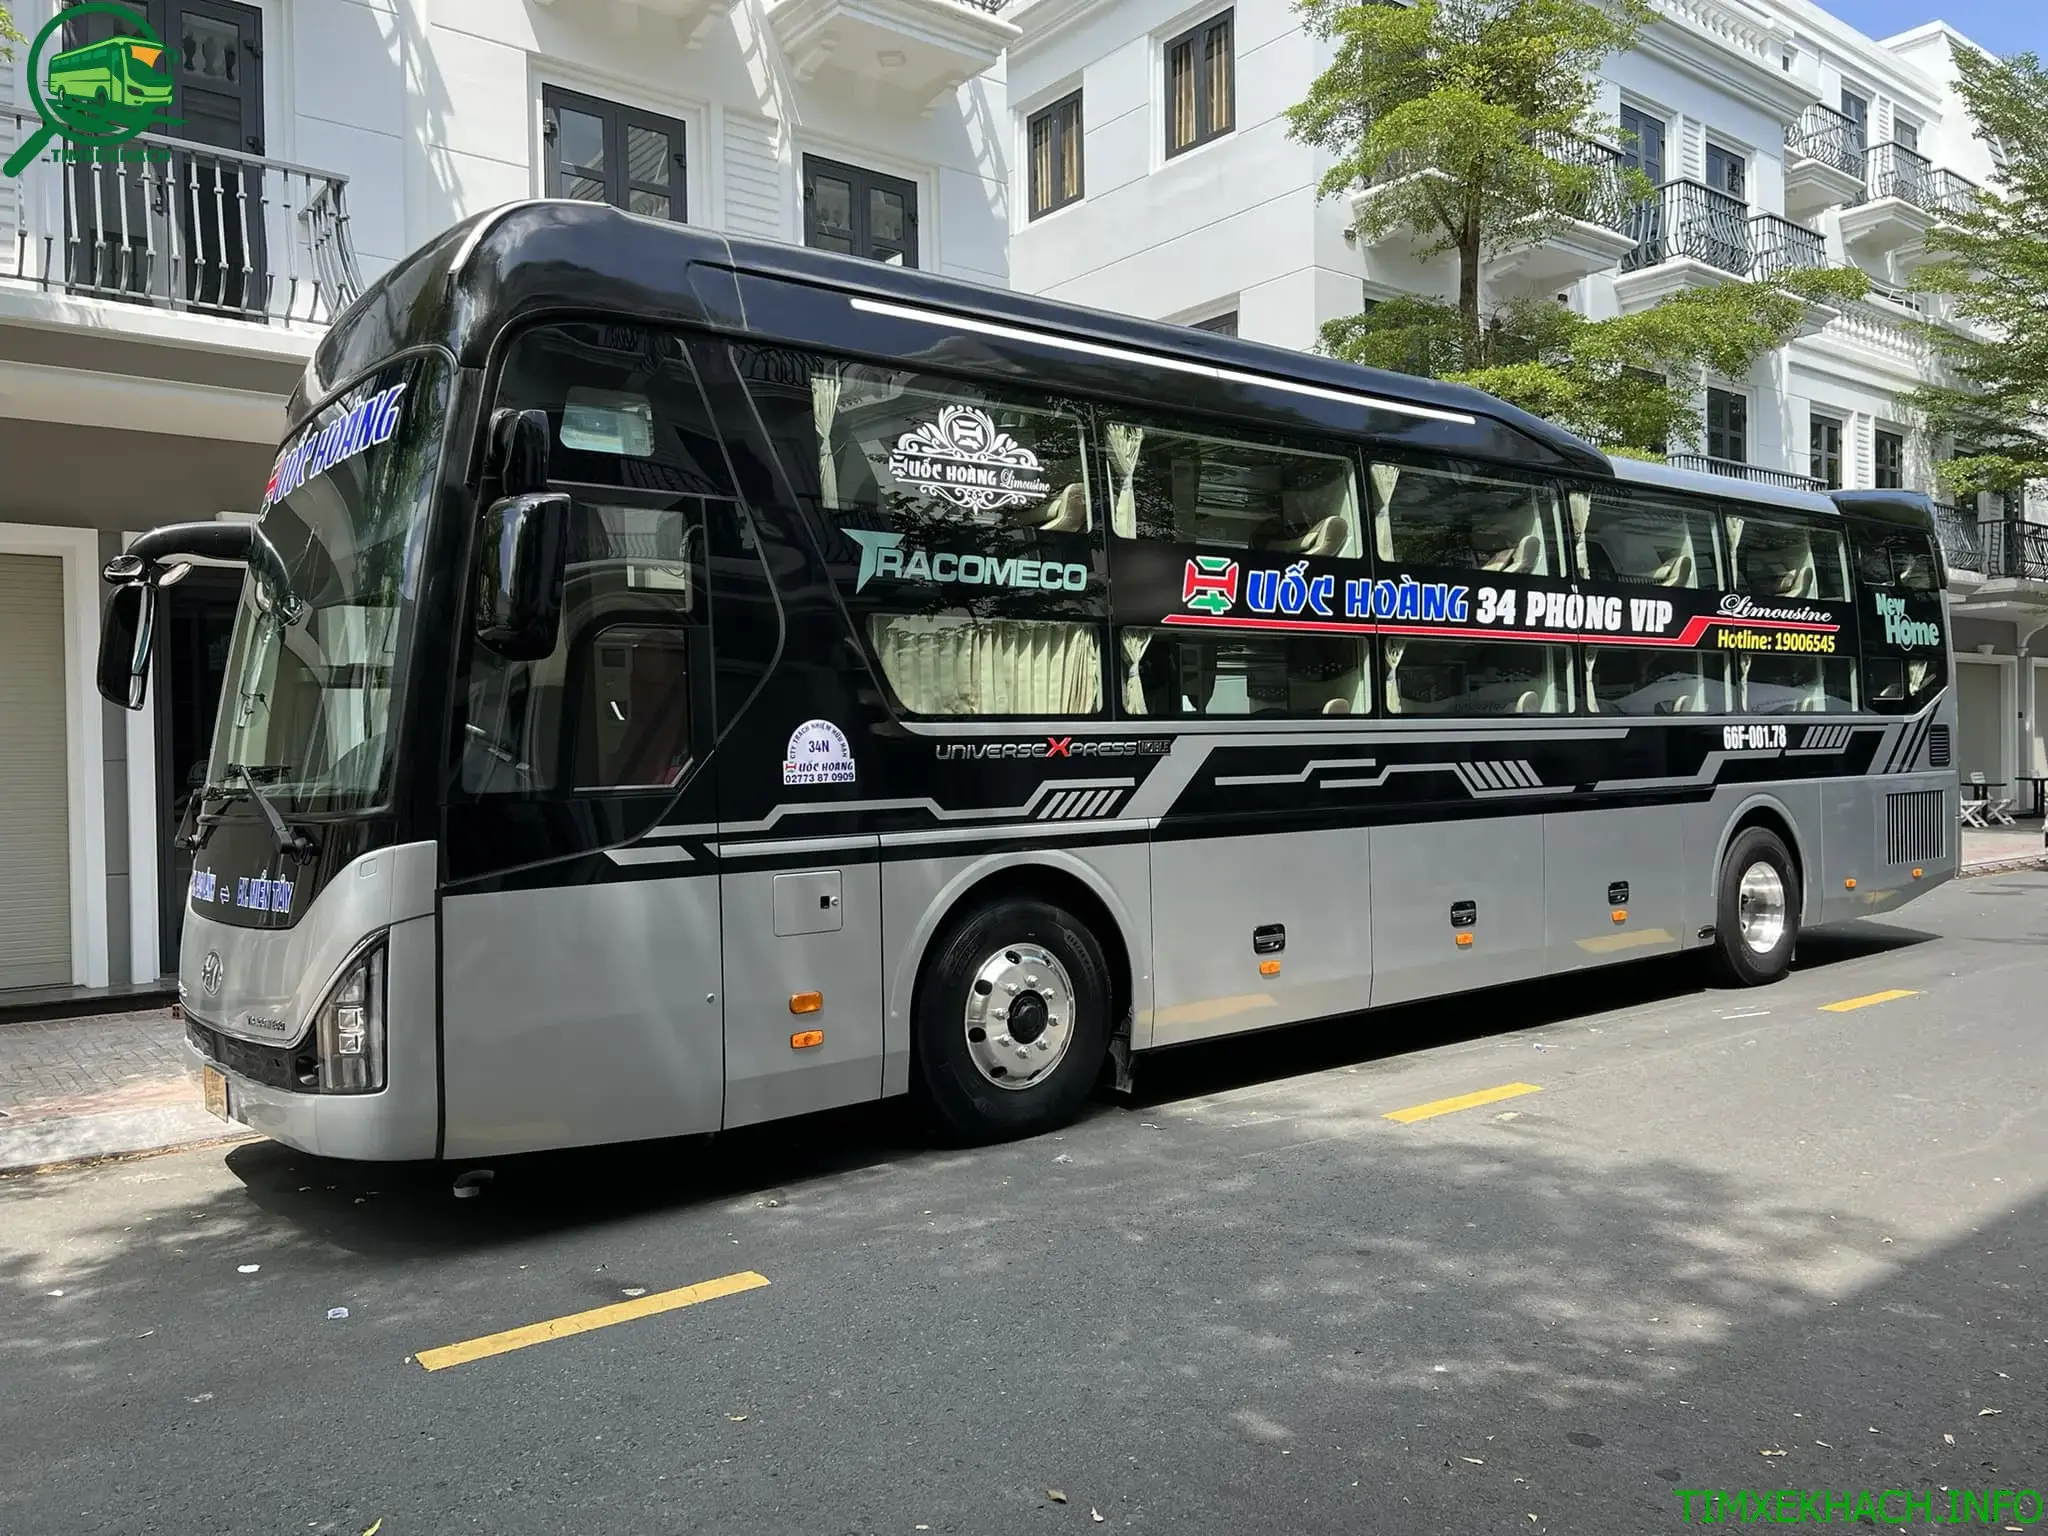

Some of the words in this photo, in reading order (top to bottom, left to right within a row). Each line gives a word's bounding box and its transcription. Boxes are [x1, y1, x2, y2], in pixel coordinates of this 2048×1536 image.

[945, 464, 998, 487] HOÀNG
[999, 467, 1051, 493] Limousine
[840, 528, 1088, 594] TRACOMECO
[1345, 574, 1470, 622] HOÀNG
[1475, 586, 1517, 625] 34
[1525, 584, 1623, 631] PHÒNG
[1629, 598, 1674, 633] VIP
[1716, 593, 1833, 622] Limousine
[1875, 592, 1906, 615] New
[1717, 629, 1772, 650] Hotline:
[1774, 632, 1836, 653] 19006545
[1885, 614, 1940, 651] Home
[808, 740, 830, 753] 34N
[1723, 725, 1787, 750] 66F-001.78
[785, 773, 815, 784] 02773
[817, 773, 829, 782] 87
[831, 771, 854, 782] 0909
